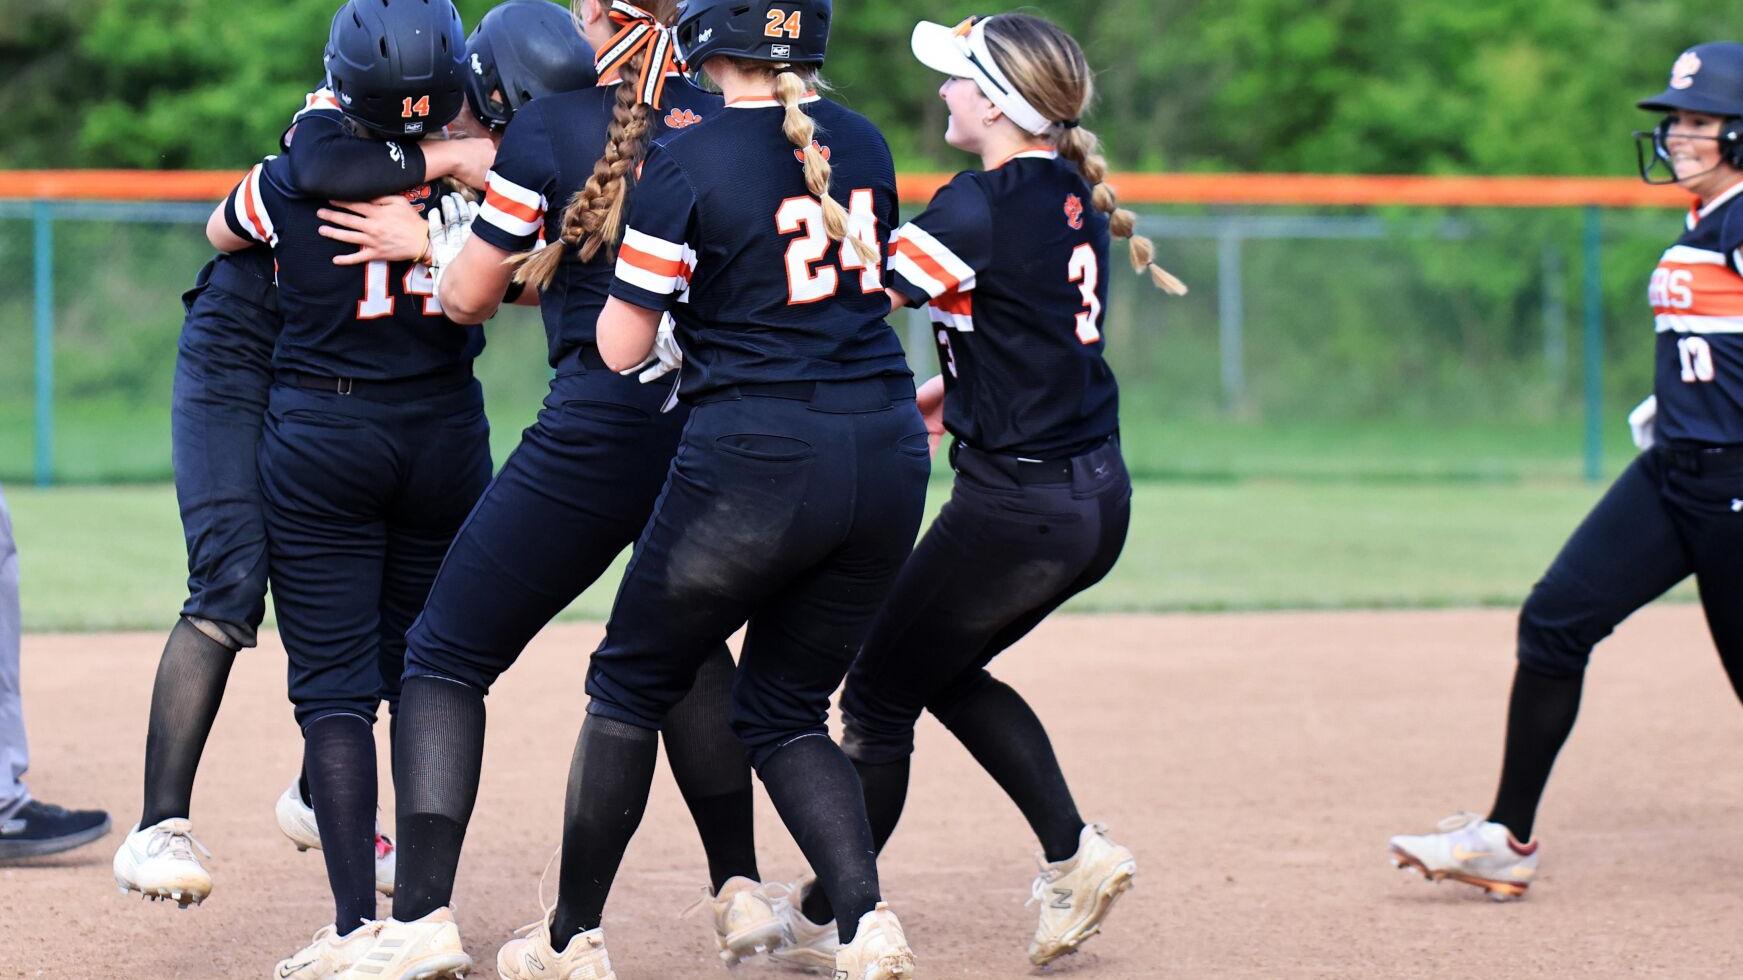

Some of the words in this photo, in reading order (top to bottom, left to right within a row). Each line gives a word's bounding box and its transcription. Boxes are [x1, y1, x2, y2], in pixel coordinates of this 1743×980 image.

[764, 8, 802, 39] 24
[401, 95, 430, 118] 14
[775, 188, 886, 305] 24
[356, 258, 443, 320] 14
[1067, 242, 1101, 344] 3
[938, 330, 957, 379] 3
